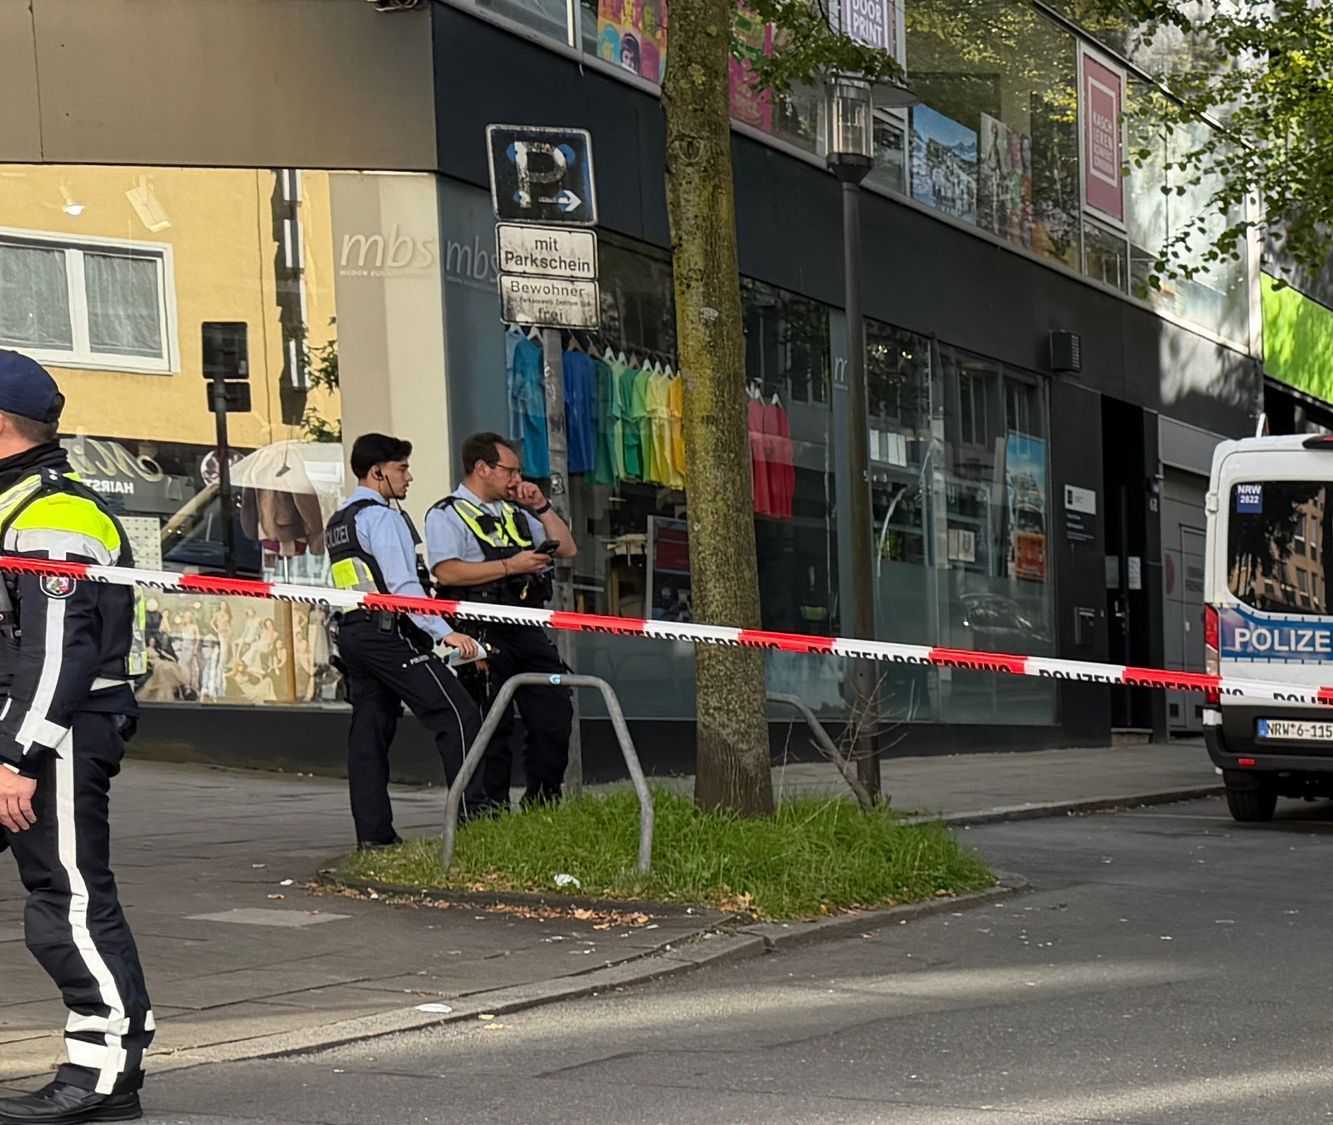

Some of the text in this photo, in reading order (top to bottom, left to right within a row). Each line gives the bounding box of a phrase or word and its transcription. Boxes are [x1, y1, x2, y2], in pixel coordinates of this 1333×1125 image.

[515, 141, 567, 209] P
[340, 222, 436, 270] mbs
[535, 237, 559, 252] mit
[504, 250, 591, 273] Parkschein
[510, 280, 586, 298] Bewohner
[538, 307, 563, 321] frei
[1237, 485, 1262, 494] NRW
